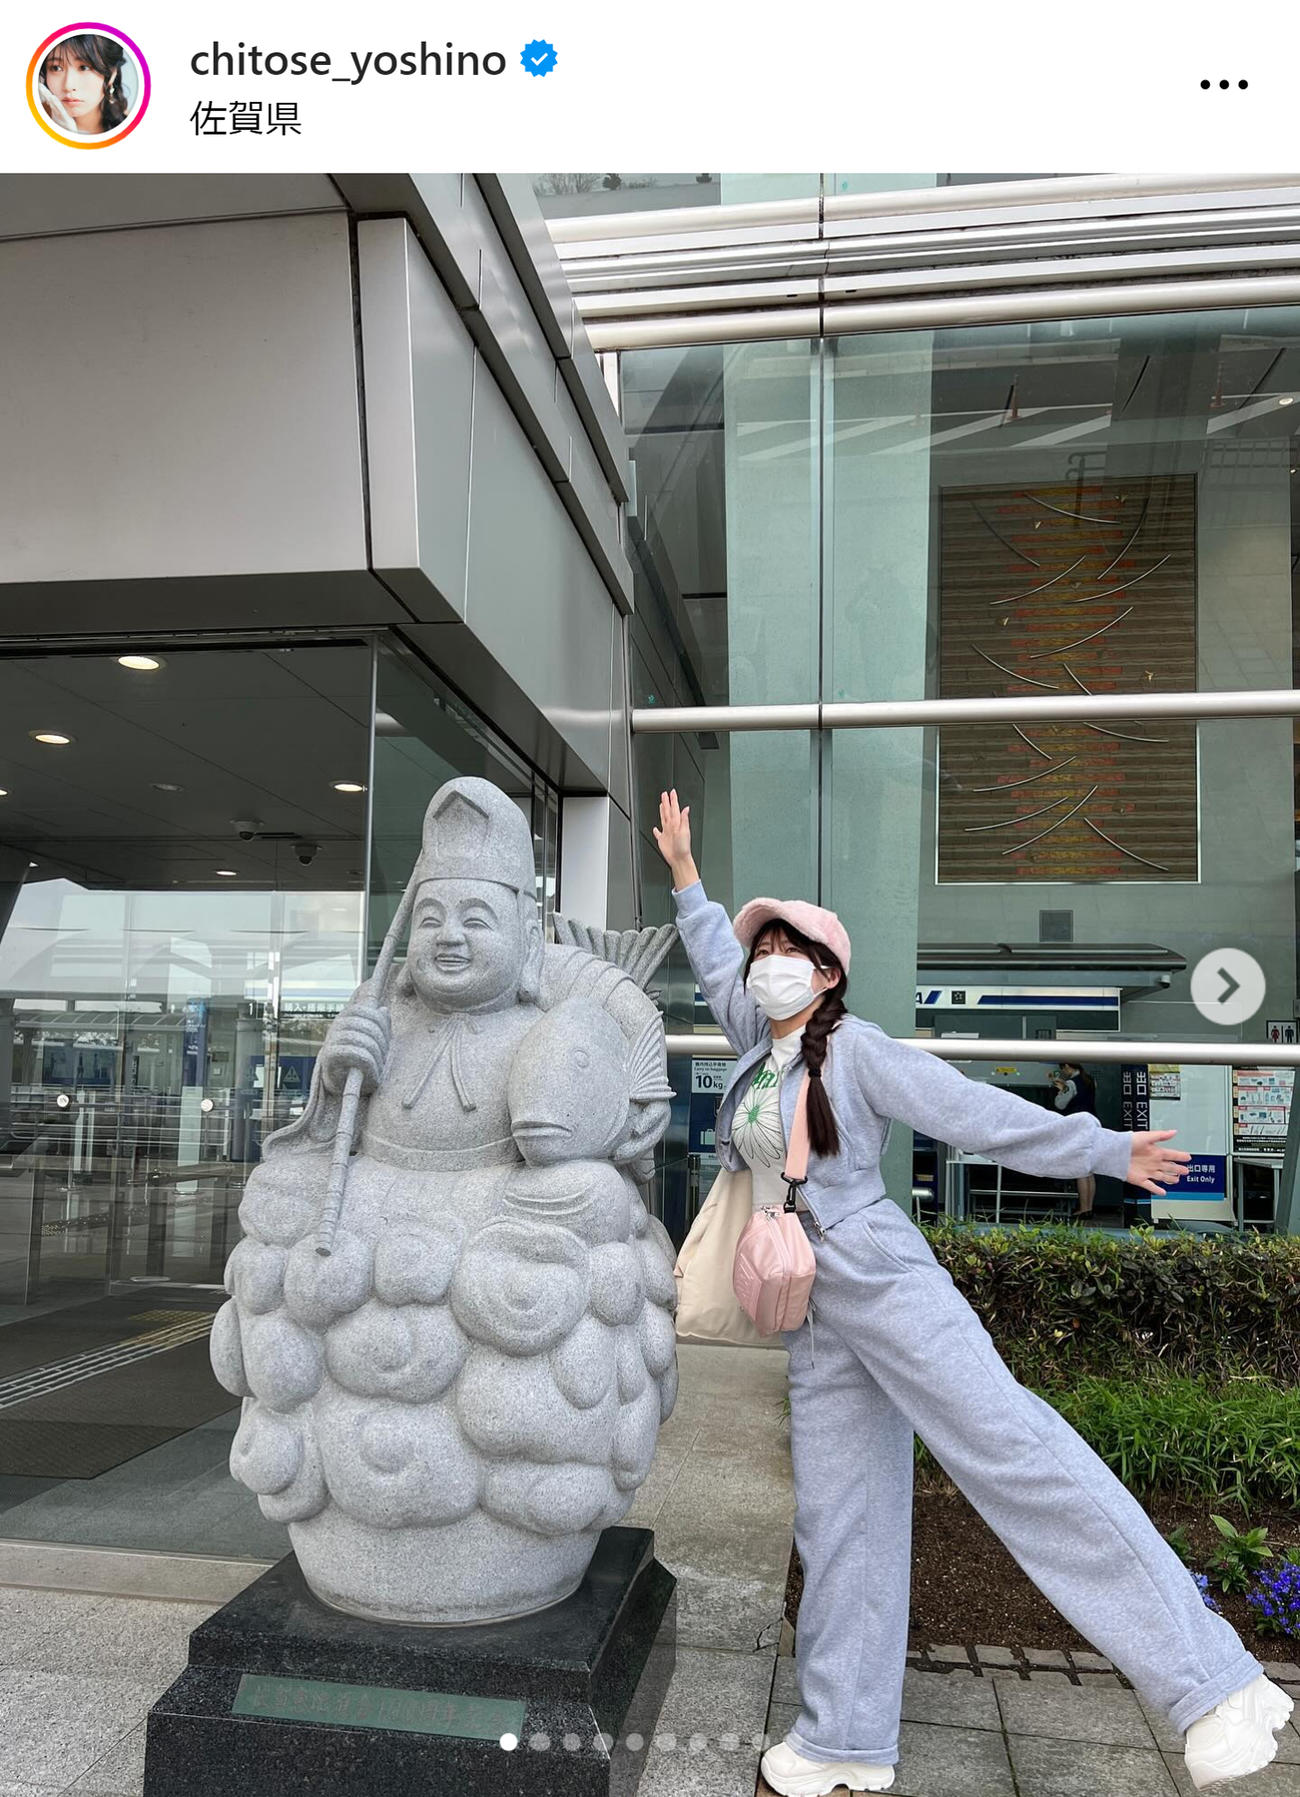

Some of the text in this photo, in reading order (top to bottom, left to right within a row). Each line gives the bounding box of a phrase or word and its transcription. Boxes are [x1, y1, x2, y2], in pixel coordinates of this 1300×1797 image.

[695, 1075, 713, 1089] 10
[713, 1081, 723, 1090] kg
[1136, 1101, 1148, 1130] EXIT
[1200, 1175, 1215, 1184] Only
